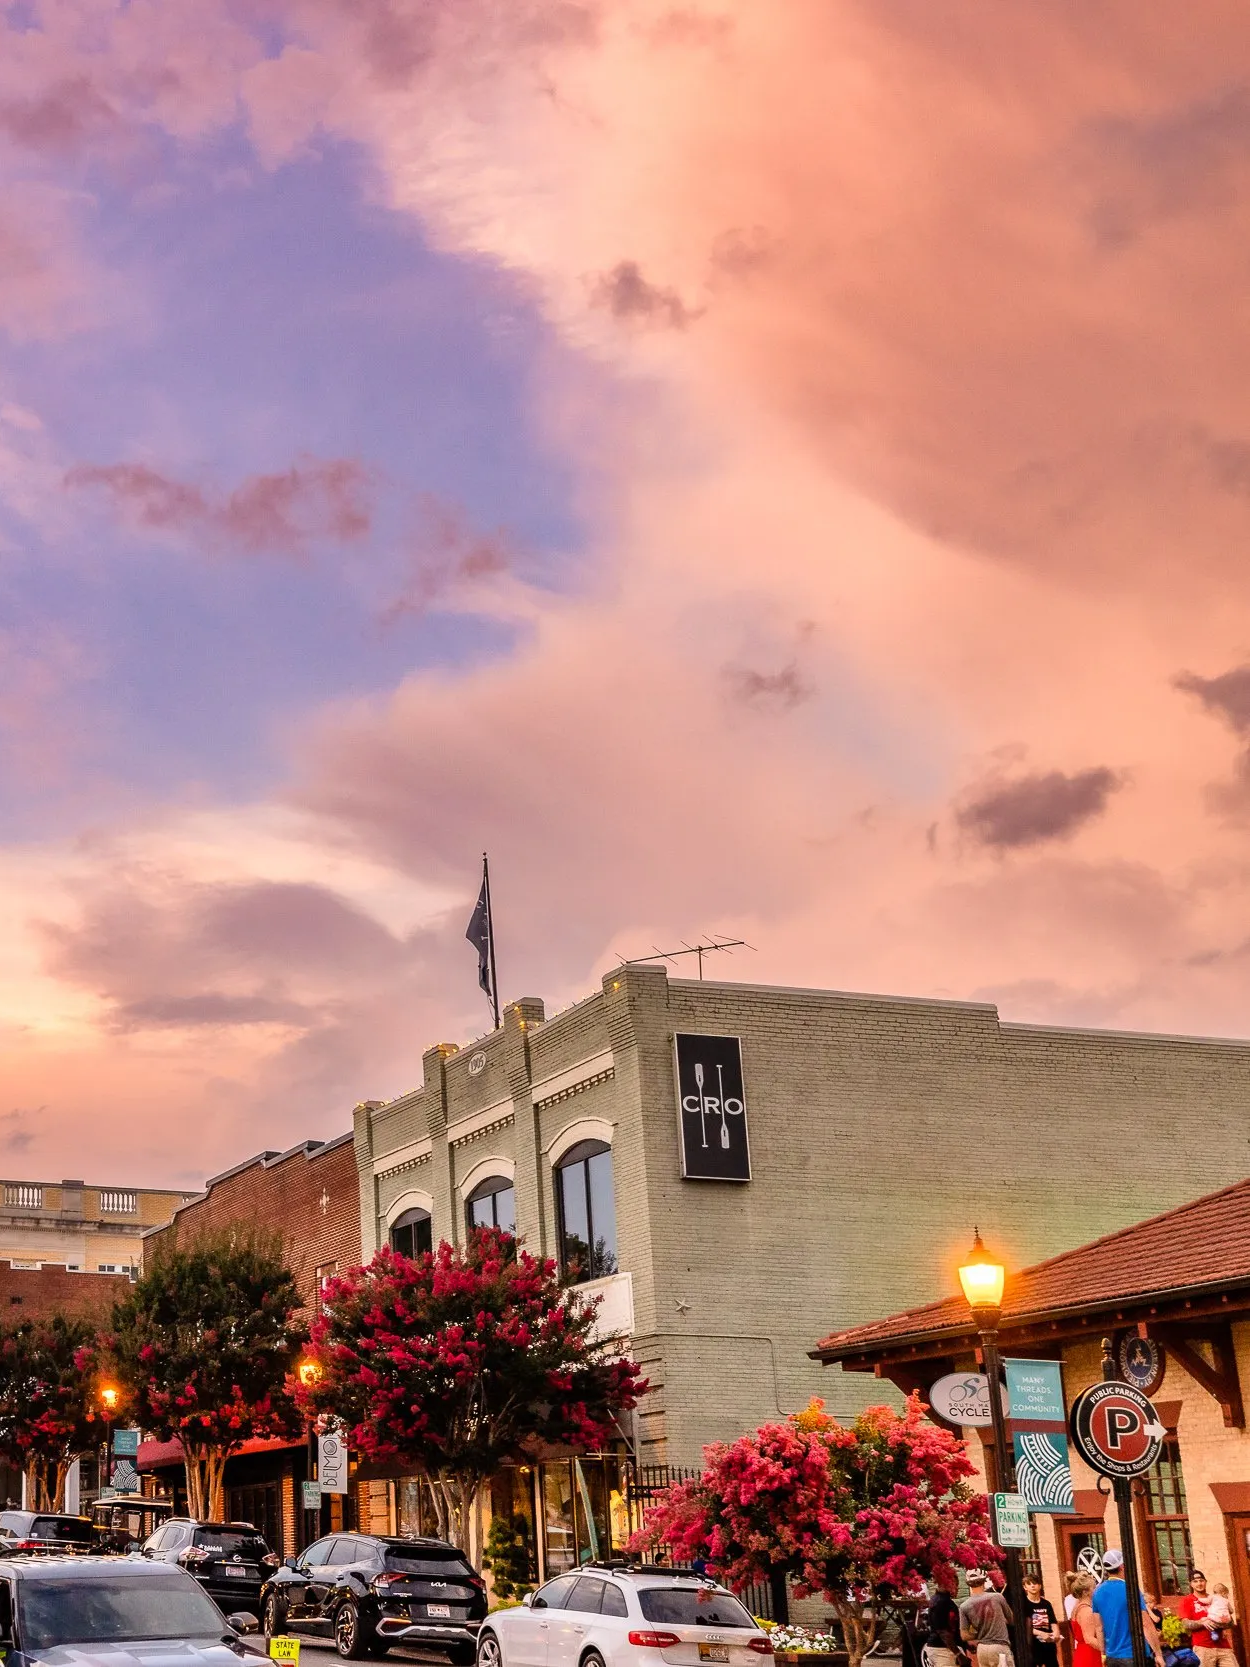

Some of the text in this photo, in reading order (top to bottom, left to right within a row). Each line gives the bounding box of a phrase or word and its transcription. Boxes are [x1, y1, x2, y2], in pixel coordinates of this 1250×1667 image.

[682, 1095, 743, 1116] CRO
[1022, 1376, 1045, 1384] MANY
[1027, 1395, 1045, 1403] ONE
[1090, 1387, 1147, 1408] PUBLIC PARKING
[949, 1407, 990, 1417] CYCLE
[1012, 1404, 1060, 1413] COMMUNITY
[1105, 1406, 1140, 1450] P
[1084, 1437, 1097, 1455] Enjoy
[1096, 1452, 1107, 1465] the
[1106, 1462, 1126, 1472] Shops
[1132, 1443, 1158, 1470] Restaurants
[997, 1495, 1005, 1508] 2
[998, 1511, 1027, 1524] PARKING
[275, 1641, 295, 1649] STATE
